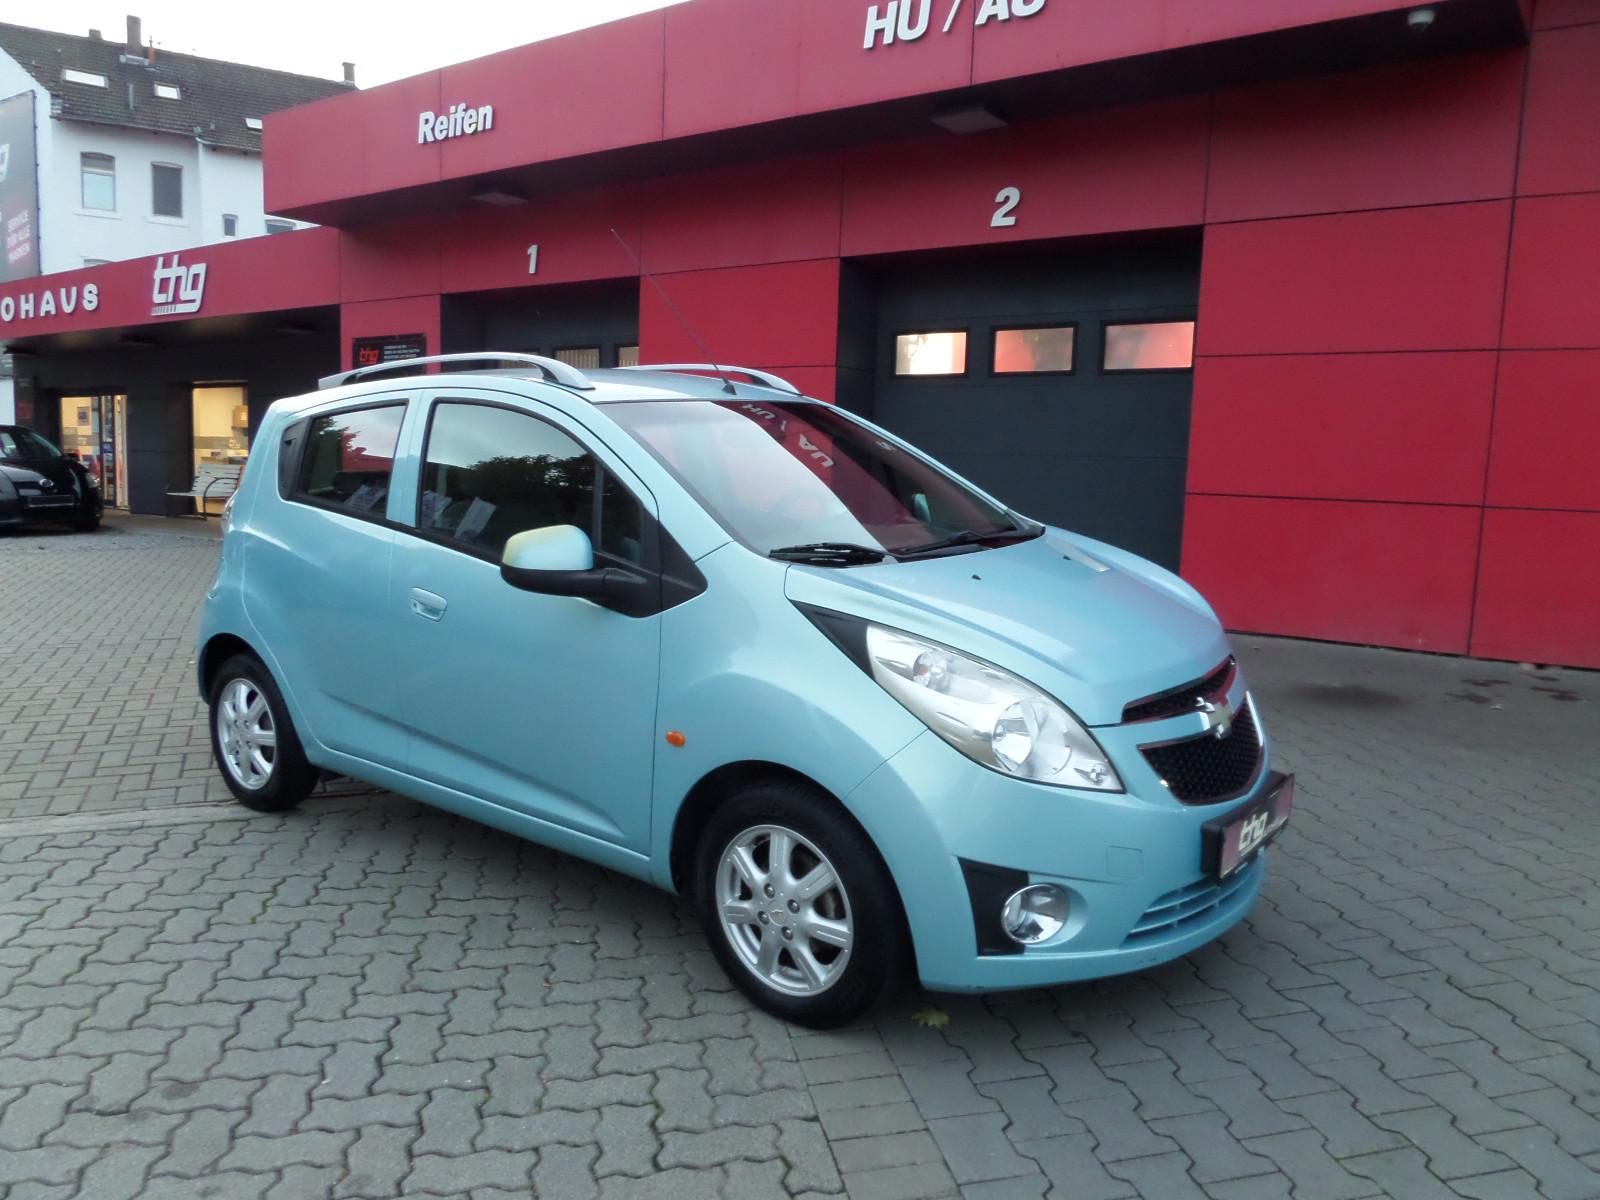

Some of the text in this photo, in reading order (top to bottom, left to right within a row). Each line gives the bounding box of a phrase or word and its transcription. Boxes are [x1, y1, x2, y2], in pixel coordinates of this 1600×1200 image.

[863, 0, 931, 49] HU
[418, 103, 493, 144] Reifen
[990, 186, 1021, 227] 2
[527, 244, 538, 274] 1
[0, 283, 99, 322] OHAUS
[151, 254, 207, 316] thg
